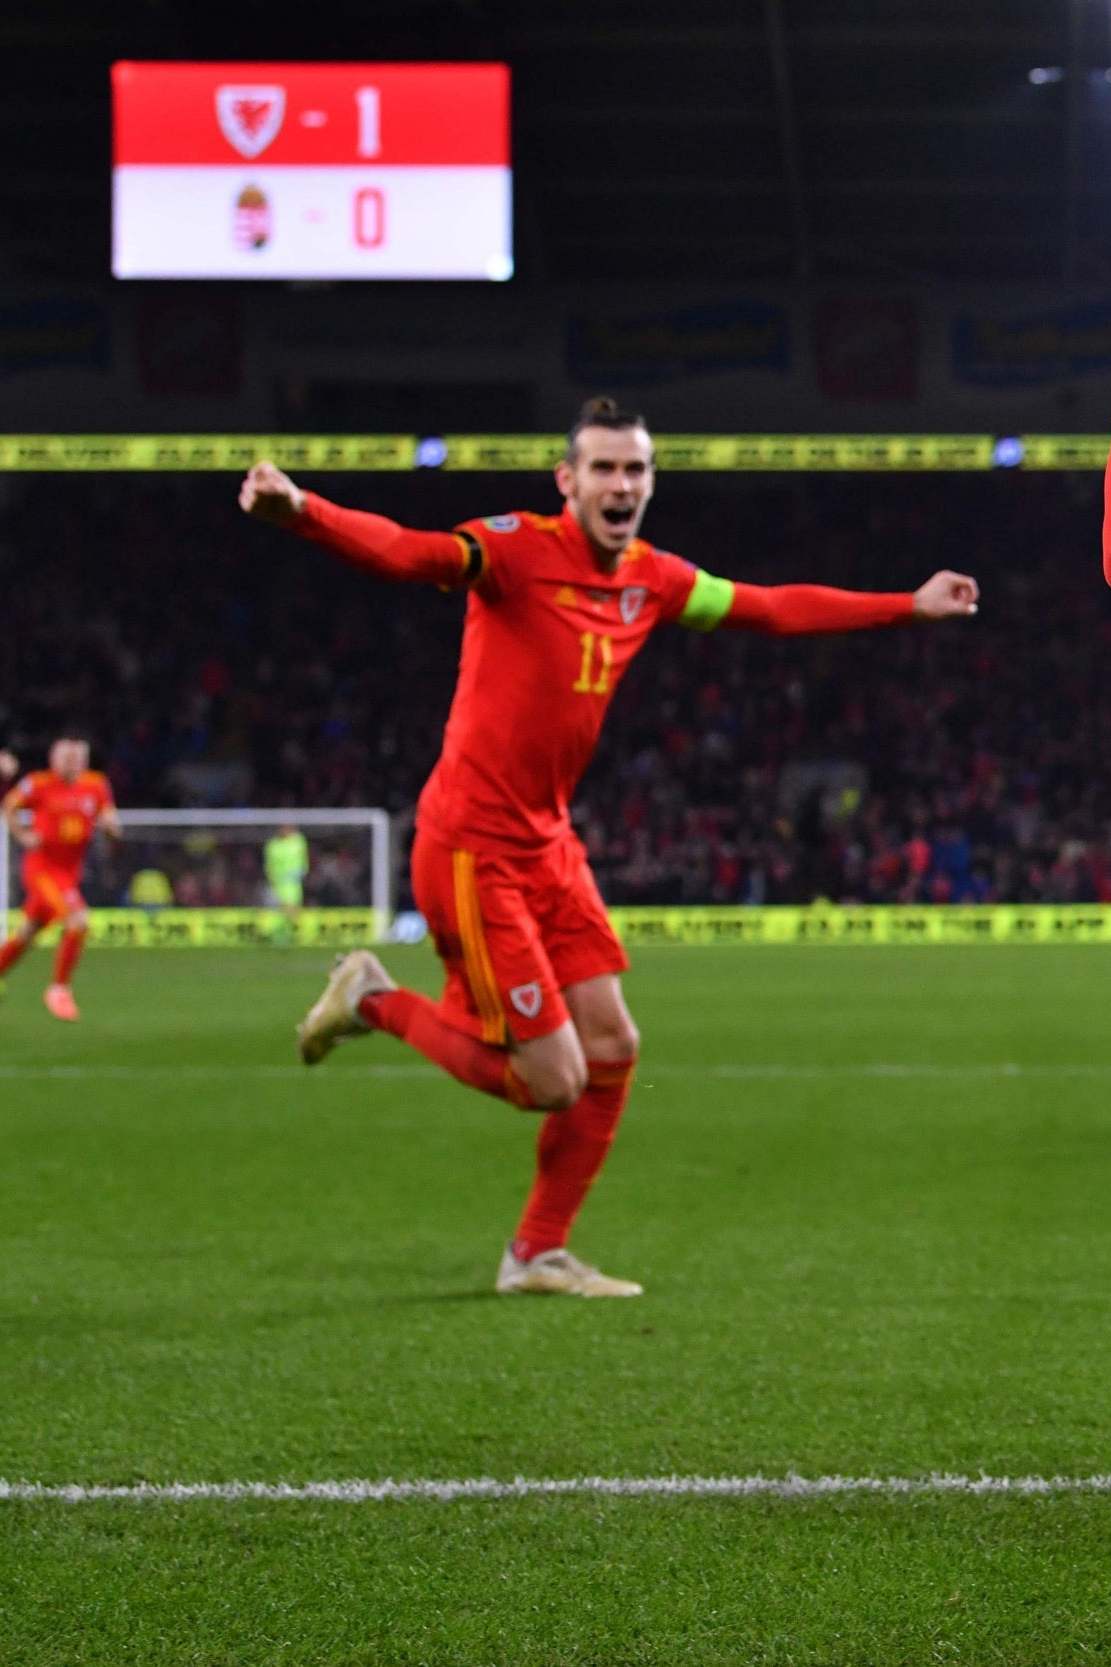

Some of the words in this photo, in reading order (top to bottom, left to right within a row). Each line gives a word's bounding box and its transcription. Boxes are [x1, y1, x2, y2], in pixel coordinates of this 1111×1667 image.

[355, 86, 381, 157] 1
[354, 187, 385, 249] 0
[573, 632, 613, 693] 11
